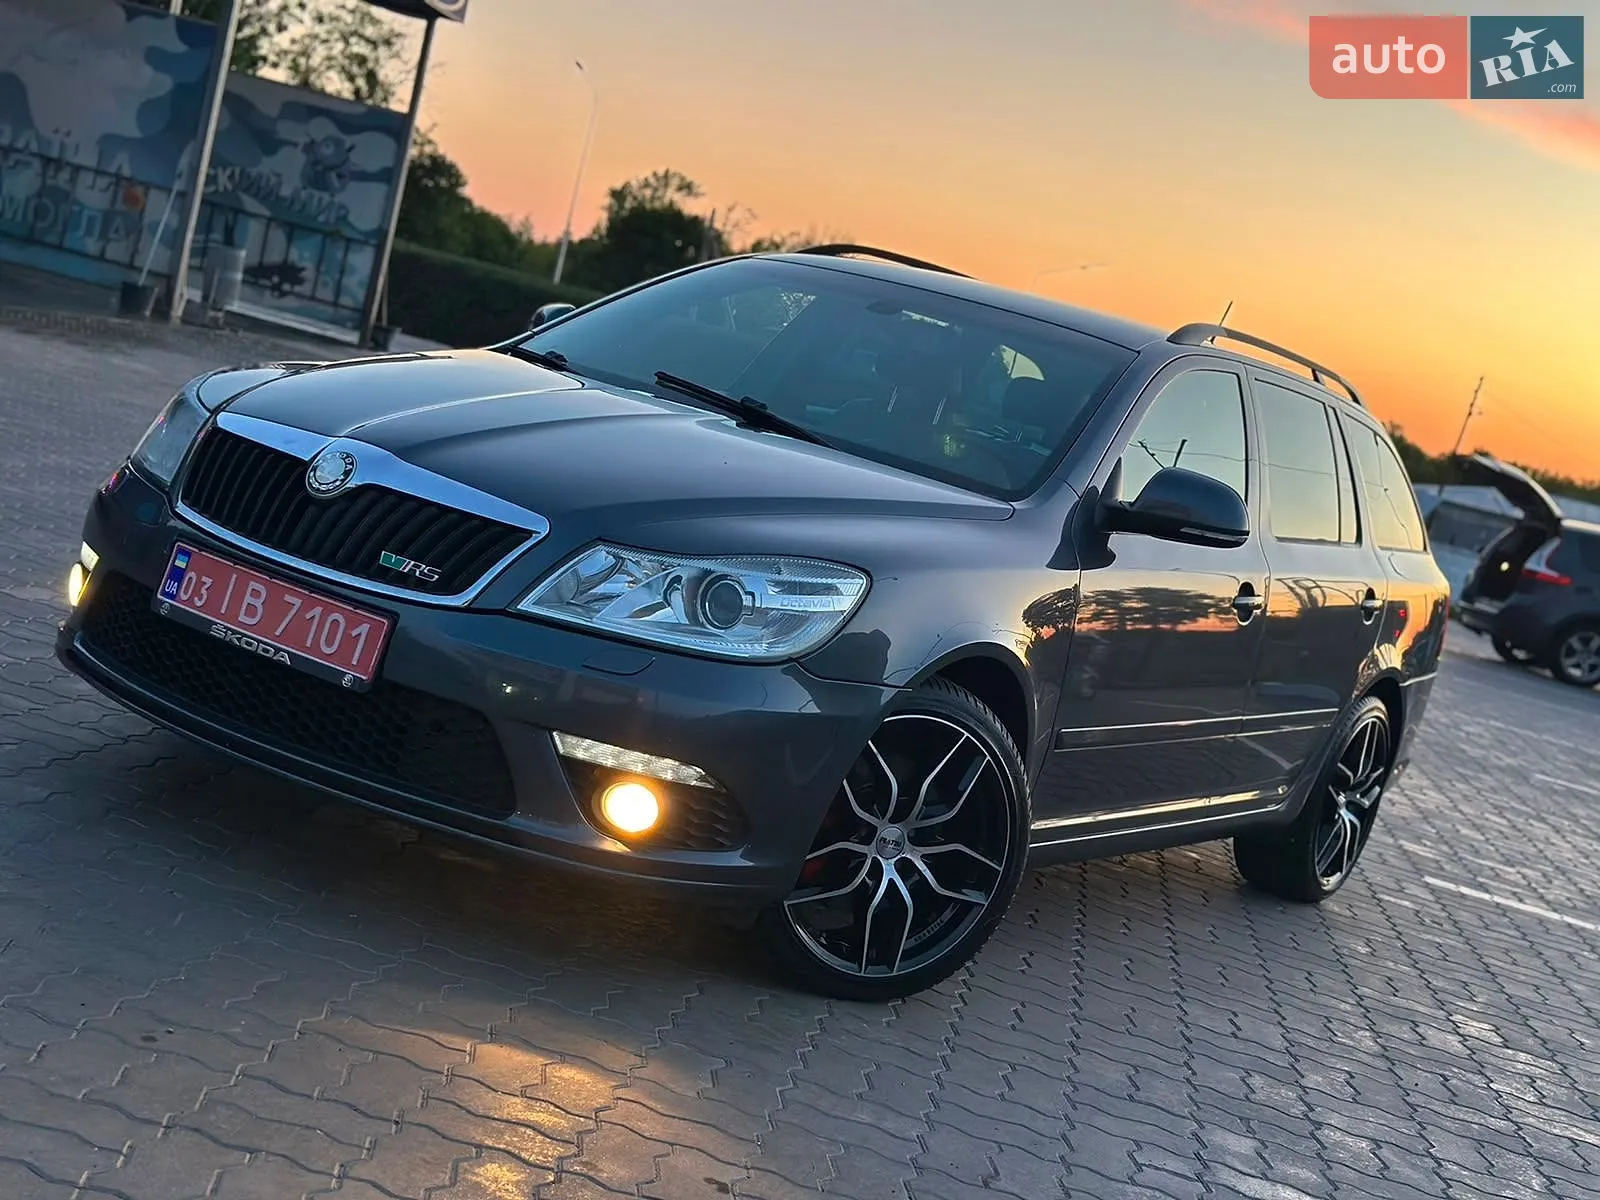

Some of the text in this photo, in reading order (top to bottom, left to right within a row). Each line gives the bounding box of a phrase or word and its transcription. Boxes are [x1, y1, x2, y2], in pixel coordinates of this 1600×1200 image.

[164, 579, 178, 595] UA
[780, 596, 831, 609] Octavia
[180, 571, 213, 607] 03
[274, 594, 370, 666] 7101
[209, 623, 291, 666] ŠKODA
